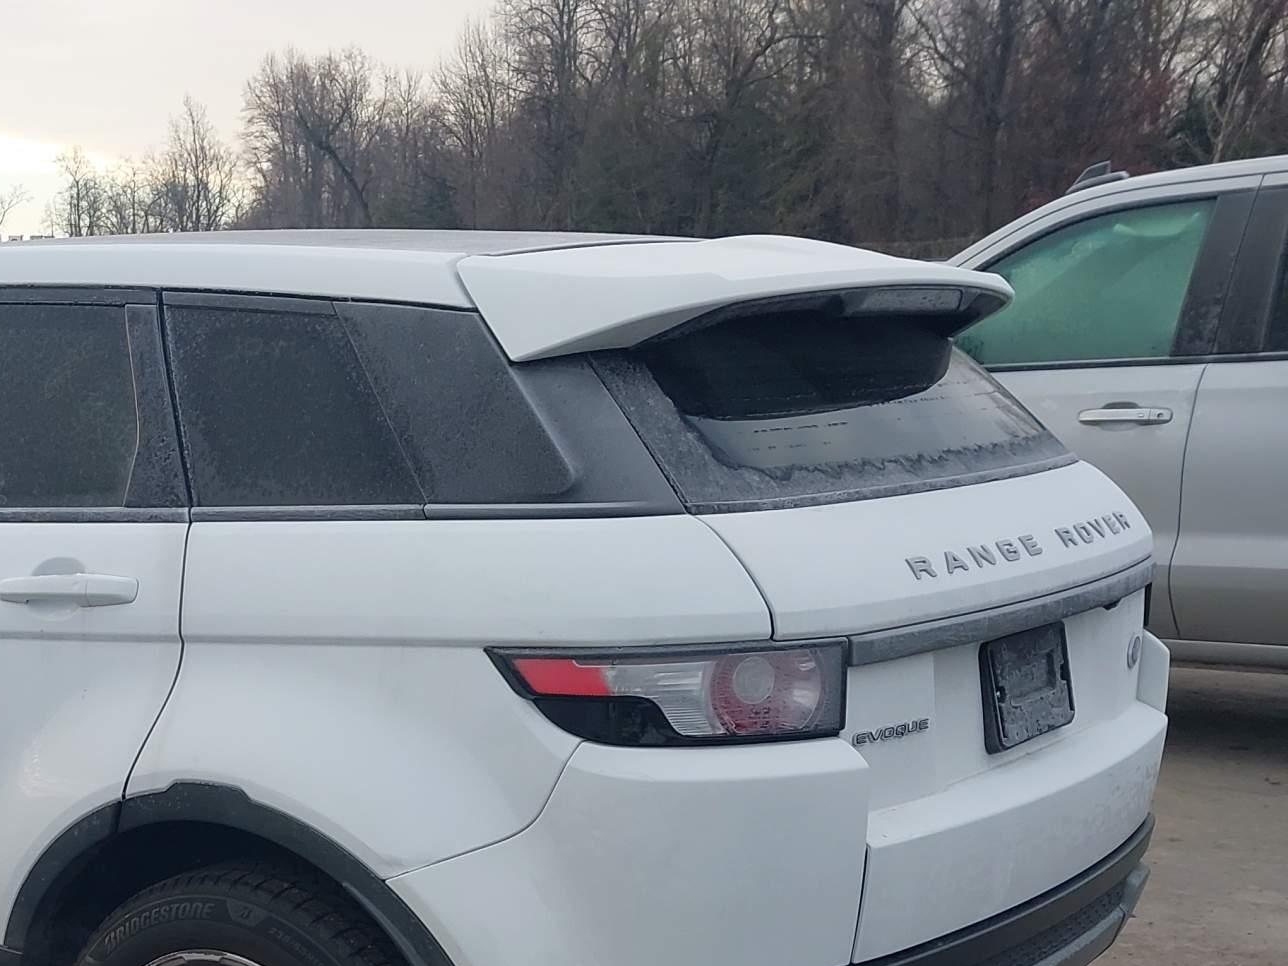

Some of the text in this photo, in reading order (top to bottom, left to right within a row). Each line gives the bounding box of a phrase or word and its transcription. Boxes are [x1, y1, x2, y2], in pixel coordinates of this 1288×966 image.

[905, 512, 1130, 580] RANGE ROVER
[853, 718, 929, 746] EVOQUE
[103, 901, 215, 953] BRIDGESTONE
